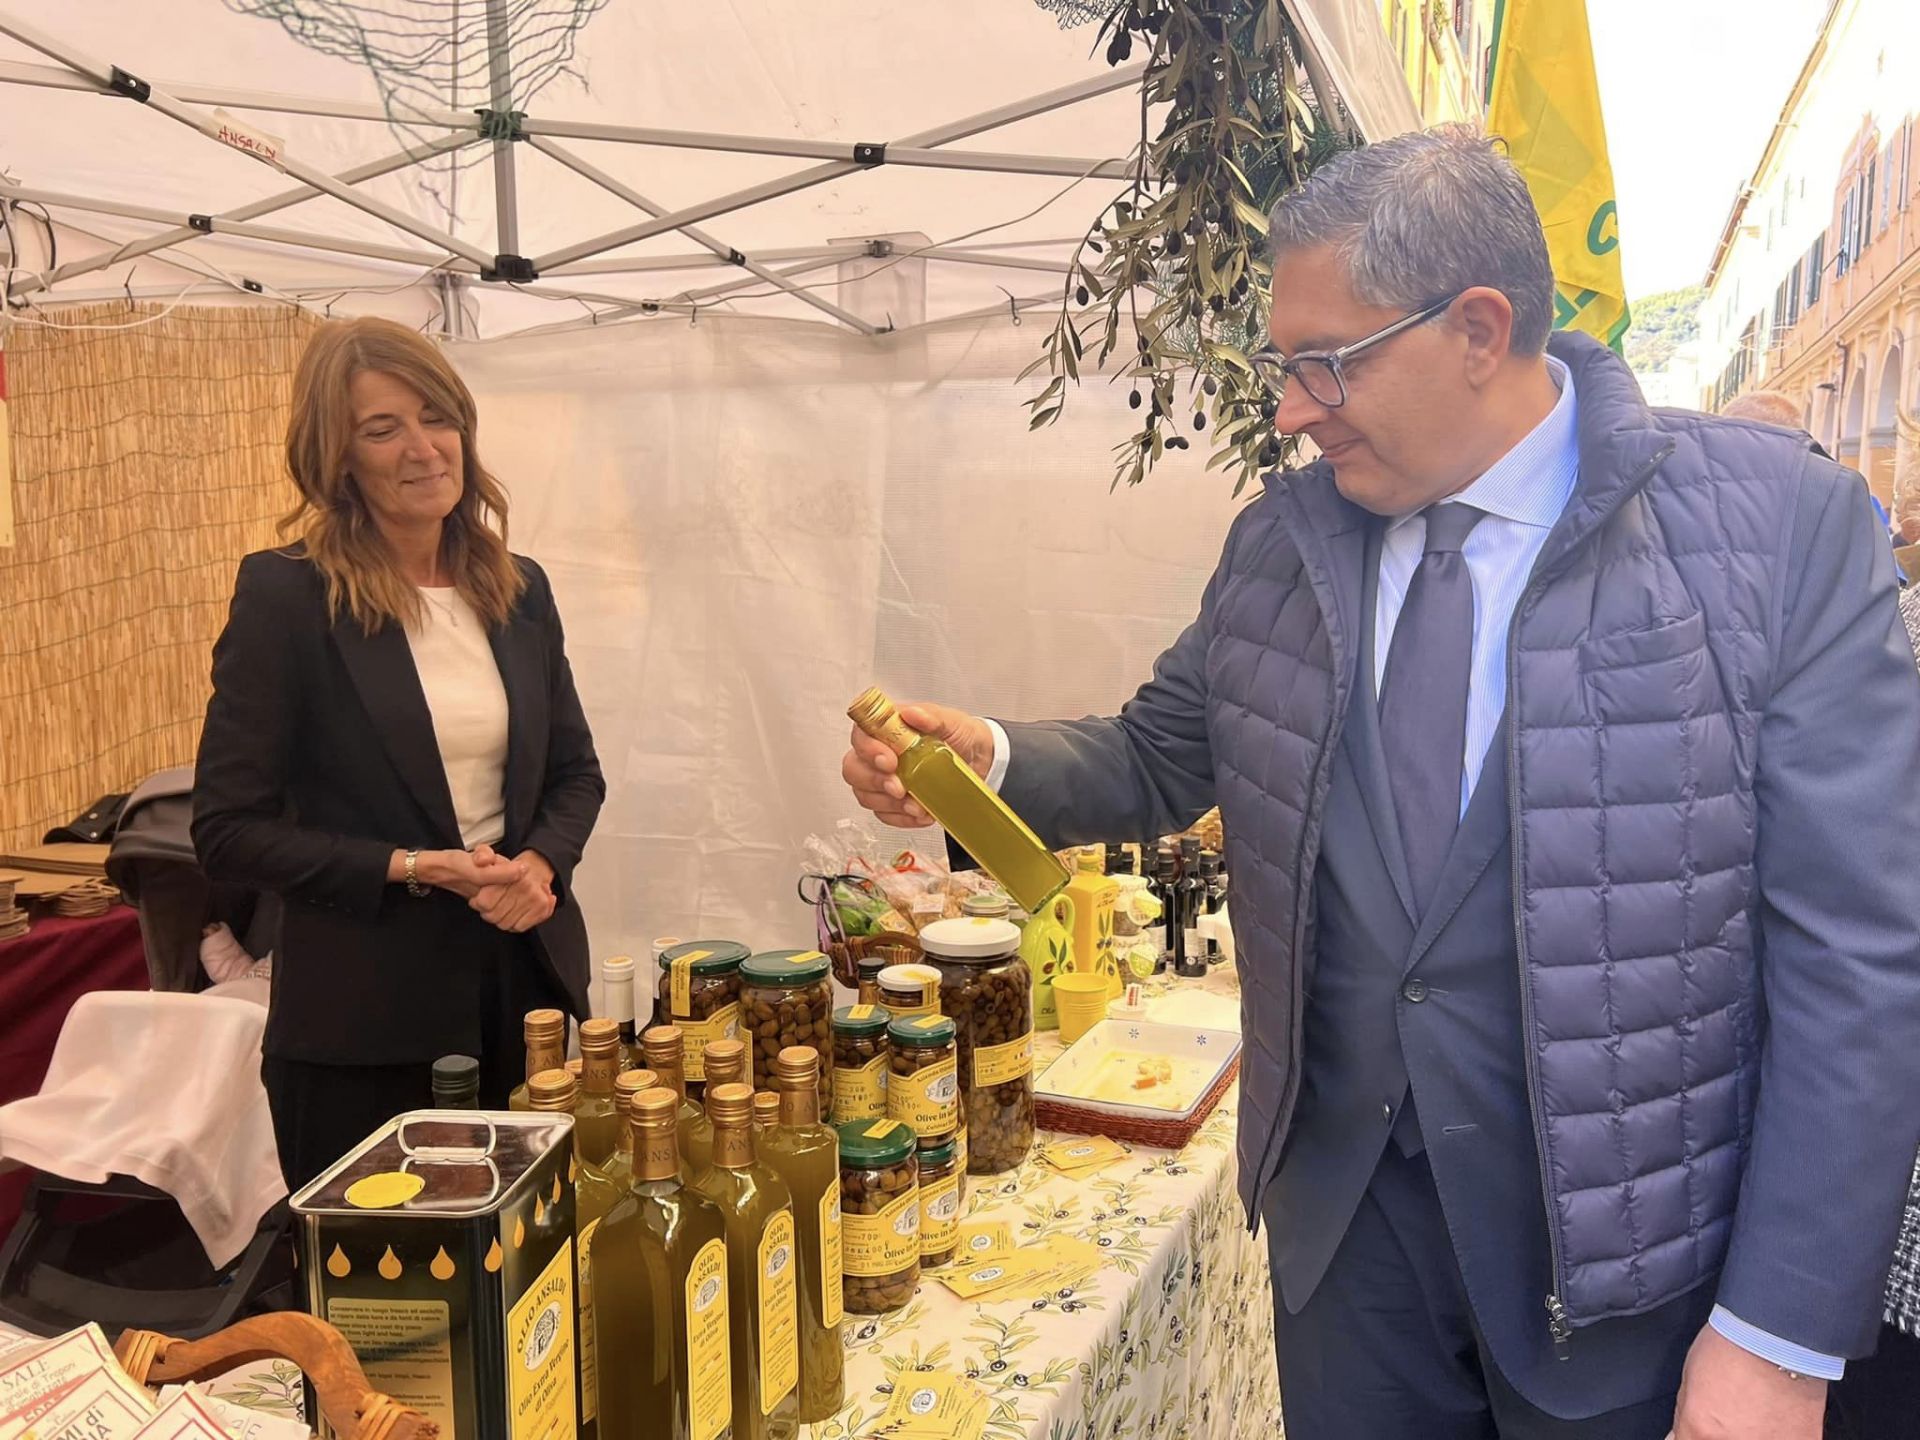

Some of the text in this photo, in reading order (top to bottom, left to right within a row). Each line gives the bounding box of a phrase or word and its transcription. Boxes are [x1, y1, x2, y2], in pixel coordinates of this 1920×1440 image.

[517, 1276, 567, 1354] OLIO ANSALDI
[86, 1404, 105, 1427] di
